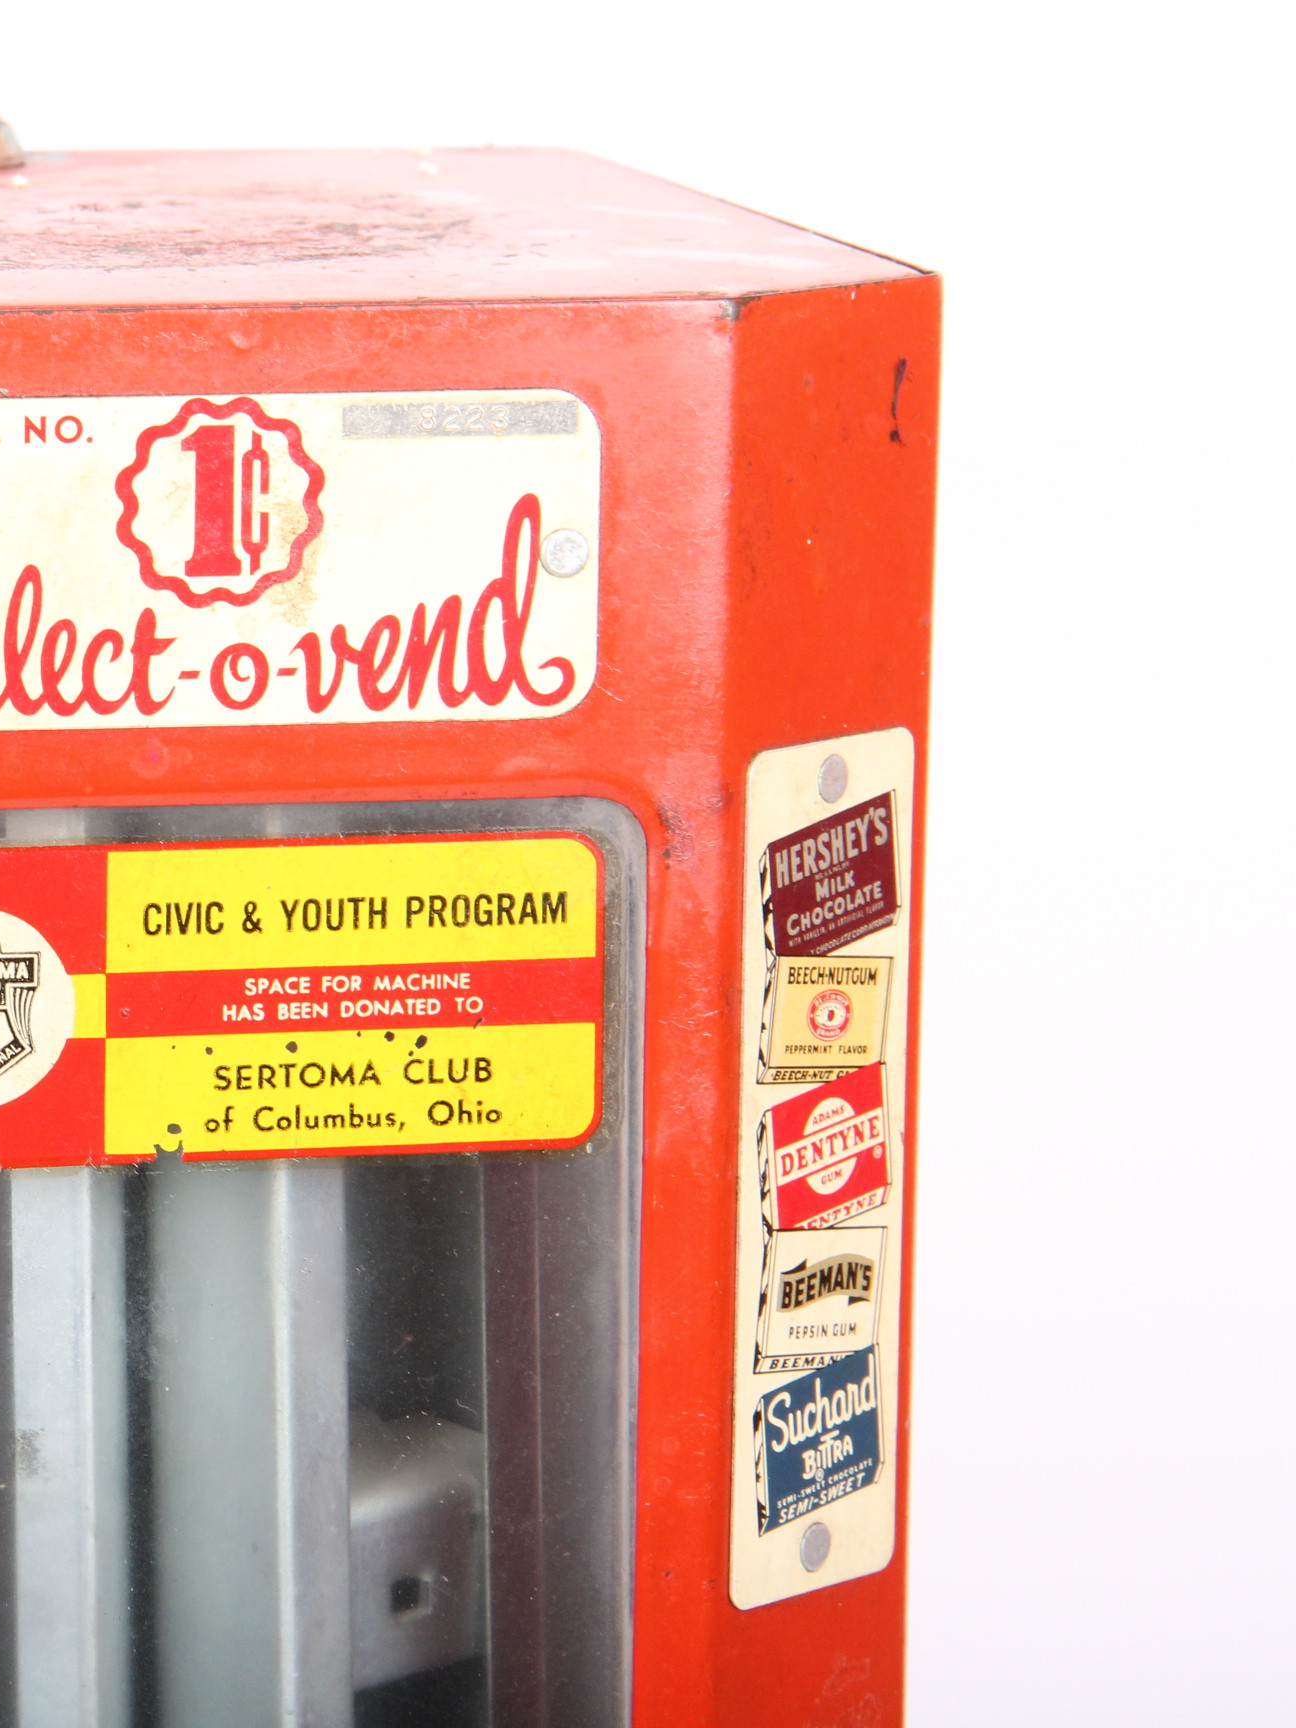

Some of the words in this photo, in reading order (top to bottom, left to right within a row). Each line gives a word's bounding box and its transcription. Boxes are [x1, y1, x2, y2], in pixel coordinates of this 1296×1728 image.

[23, 416, 94, 445] NO.
[419, 405, 509, 432] 8223
[775, 807, 888, 889] HERSHEY'S
[815, 870, 856, 903] MILK
[143, 902, 224, 937] CIVIC
[243, 902, 263, 934] &
[283, 896, 389, 932] YOUTH
[406, 891, 569, 929] PROGRAM
[786, 881, 883, 936] CHOCOLATE
[244, 975, 311, 996] SPACE
[321, 974, 366, 994] FOR
[373, 971, 471, 992] MACHINE
[222, 1001, 270, 1022] HAS
[278, 999, 330, 1020] BEEN
[339, 996, 444, 1018] DONATED
[454, 996, 484, 1017] TO
[785, 1044, 832, 1055] PEPPERMINT
[838, 1044, 868, 1055] FLAVOR
[213, 1061, 380, 1092] SERTOMA
[404, 1055, 493, 1084] CLUB
[204, 1104, 236, 1135] of
[253, 1101, 406, 1133] Columbus,
[427, 1097, 503, 1128] Ohio
[811, 1104, 845, 1126] ADAMS
[780, 1115, 880, 1178] DENTYNE
[821, 1168, 843, 1186] GUM
[781, 1261, 872, 1309] BEEMAN'S
[788, 1325, 827, 1341] PEPSIN
[832, 1323, 857, 1338] GUM
[767, 1353, 876, 1453] Suchard
[777, 1480, 825, 1509] SEMI-SWEET
[828, 1458, 873, 1485] CHOCOLATE
[779, 1472, 866, 1524] SEMI-SWEET
